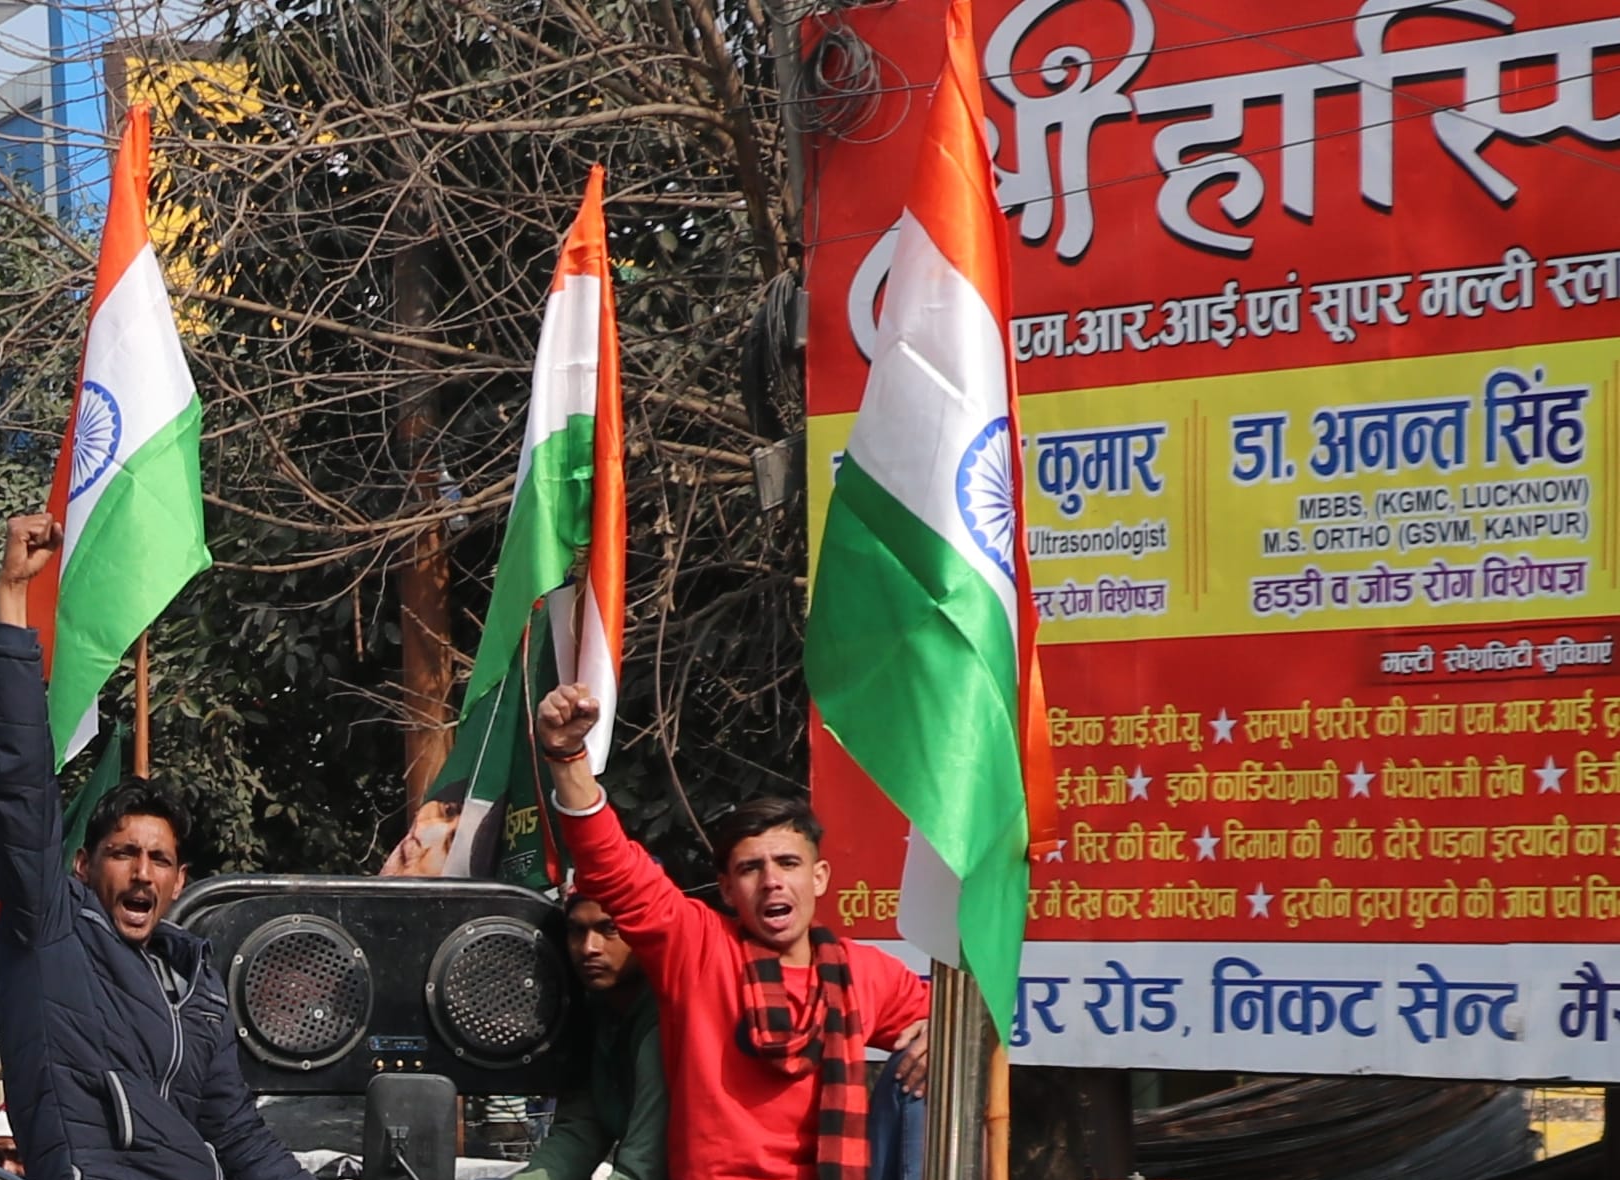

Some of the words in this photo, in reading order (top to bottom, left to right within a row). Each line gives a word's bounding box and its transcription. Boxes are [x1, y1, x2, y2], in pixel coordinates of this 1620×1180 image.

[1310, 275, 1412, 342] सूपर
[1419, 247, 1537, 317] मल्टी
[1232, 415, 1294, 481] डा.
[1310, 400, 1471, 476] अनन्त
[1484, 369, 1589, 465] सिंह
[1037, 426, 1166, 515] कुमार
[1299, 494, 1368, 520] MBBS,
[1375, 488, 1455, 516] (KGMC,
[1462, 478, 1590, 510] LUCKNOW)
[1264, 531, 1306, 554] M.S.
[1313, 525, 1391, 551] ORTHO
[1398, 519, 1478, 549] (GSVM,
[1484, 510, 1590, 543] KANPUR)
[1059, 583, 1094, 616] रोग
[1098, 579, 1166, 613] विशेषज्ञ
[1331, 575, 1350, 605] व
[1423, 562, 1476, 602] रोग
[1483, 556, 1587, 597] विशेषज्ञ
[1381, 644, 1435, 674] मल्टी
[1315, 697, 1373, 741] शरीर
[1376, 695, 1408, 737] की
[1165, 762, 1210, 809] इको
[1486, 755, 1526, 799] लैब
[1073, 821, 1109, 863] सिर
[1115, 822, 1145, 862] की
[1223, 818, 1288, 862] दिमाग
[1290, 818, 1323, 861] की
[1573, 824, 1607, 859] का
[1066, 881, 1105, 920] देख
[1106, 888, 1143, 920] कर
[1463, 878, 1496, 919] की
[1211, 956, 1381, 1037] निकट
